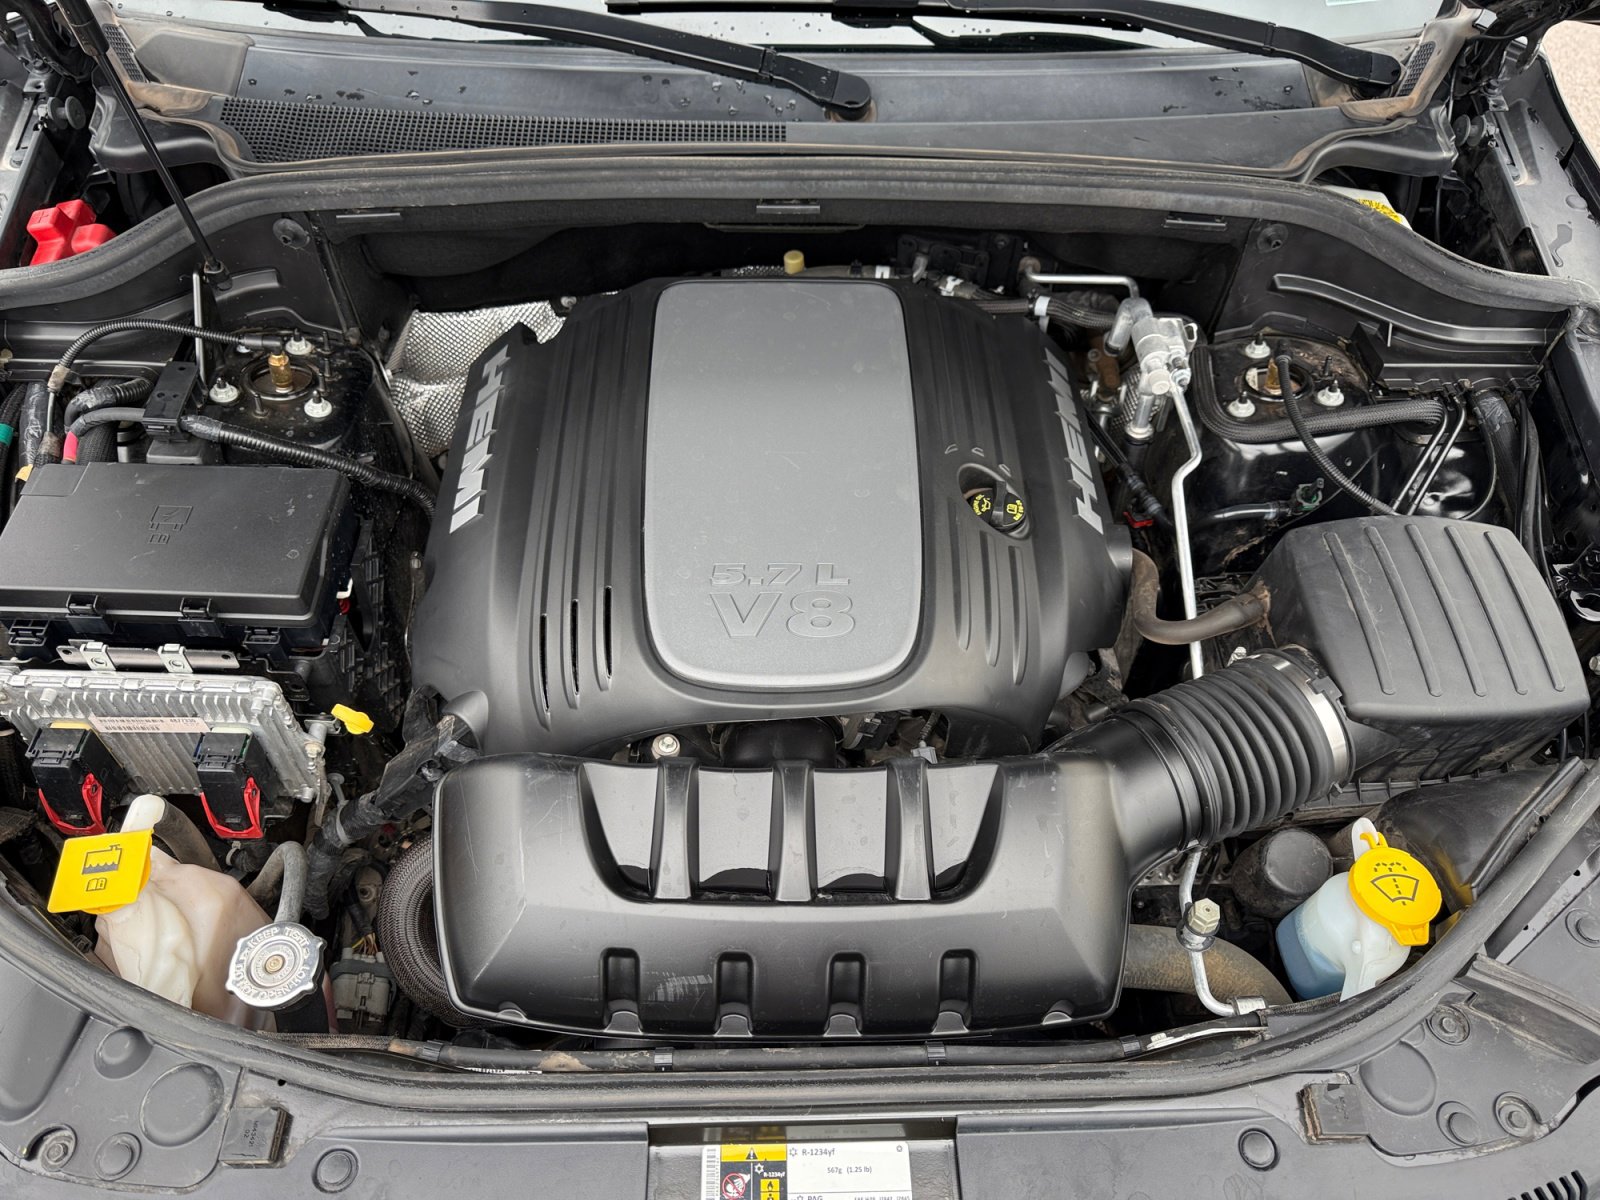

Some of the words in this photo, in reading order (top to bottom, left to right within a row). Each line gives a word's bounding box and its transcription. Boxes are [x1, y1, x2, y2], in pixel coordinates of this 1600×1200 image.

[449, 344, 509, 534] HEMI
[1045, 347, 1105, 536] HEMI
[709, 590, 855, 638] V8
[247, 927, 281, 949] KEEP
[802, 1147, 836, 1157] R-1234yf
[827, 1166, 843, 1175] 567g
[846, 1166, 863, 1175] (1.25
[863, 1165, 873, 1174] lb)
